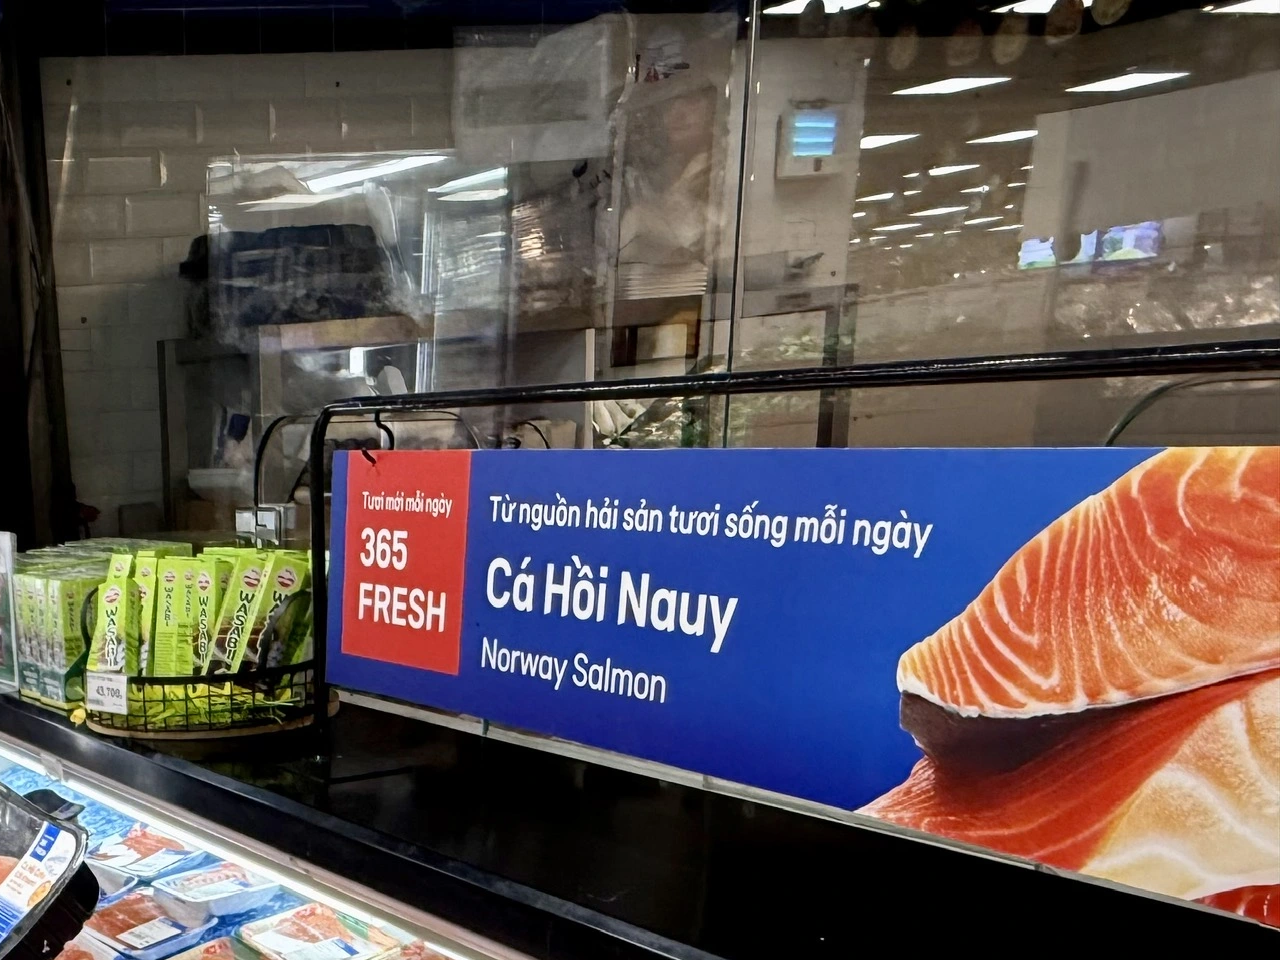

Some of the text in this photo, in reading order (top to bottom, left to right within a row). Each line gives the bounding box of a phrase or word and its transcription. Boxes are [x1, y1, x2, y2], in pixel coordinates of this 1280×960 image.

[362, 489, 453, 518] Tươi mới mỗi ngày
[489, 492, 933, 558] Từ nguồn hải sản tươi sống mỗi ngày
[359, 527, 409, 570] 365
[198, 595, 209, 665] WASABI
[227, 589, 256, 664] WASABI
[358, 582, 447, 632] FRESH
[486, 555, 739, 653] Cá Hồi Nauy
[481, 636, 667, 703] Norway Salmon
